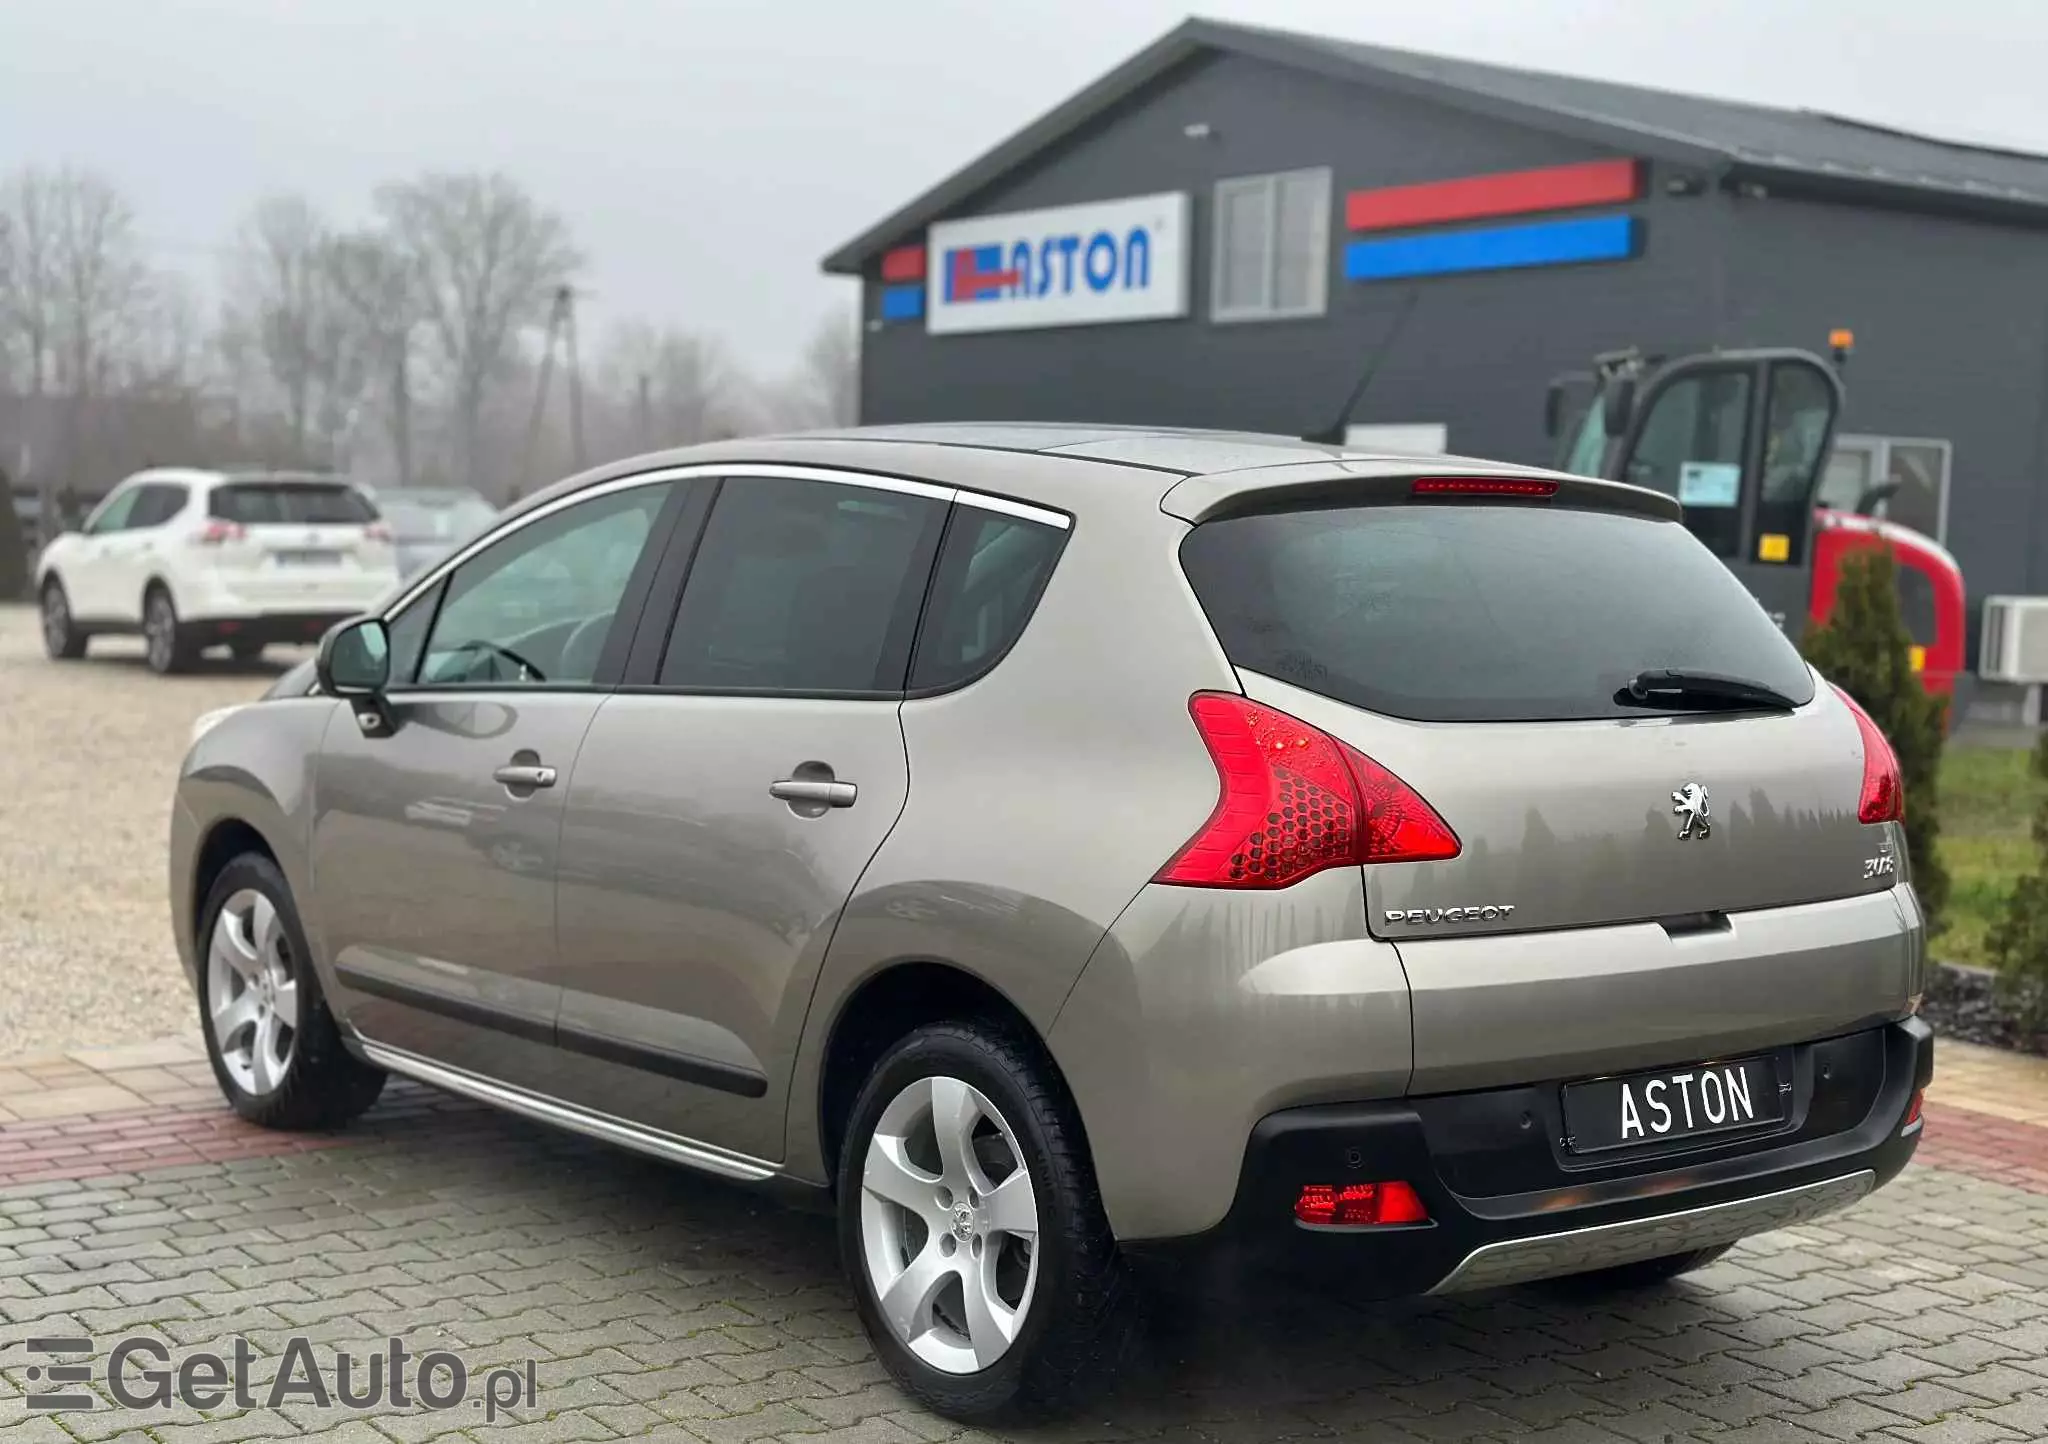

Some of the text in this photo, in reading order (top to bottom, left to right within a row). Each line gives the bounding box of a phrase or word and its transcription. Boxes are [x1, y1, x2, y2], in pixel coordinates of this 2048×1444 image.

[1009, 226, 1151, 300] ASTON
[1385, 905, 1515, 926] PEUGEOT
[1621, 1066, 1754, 1139] ASTON
